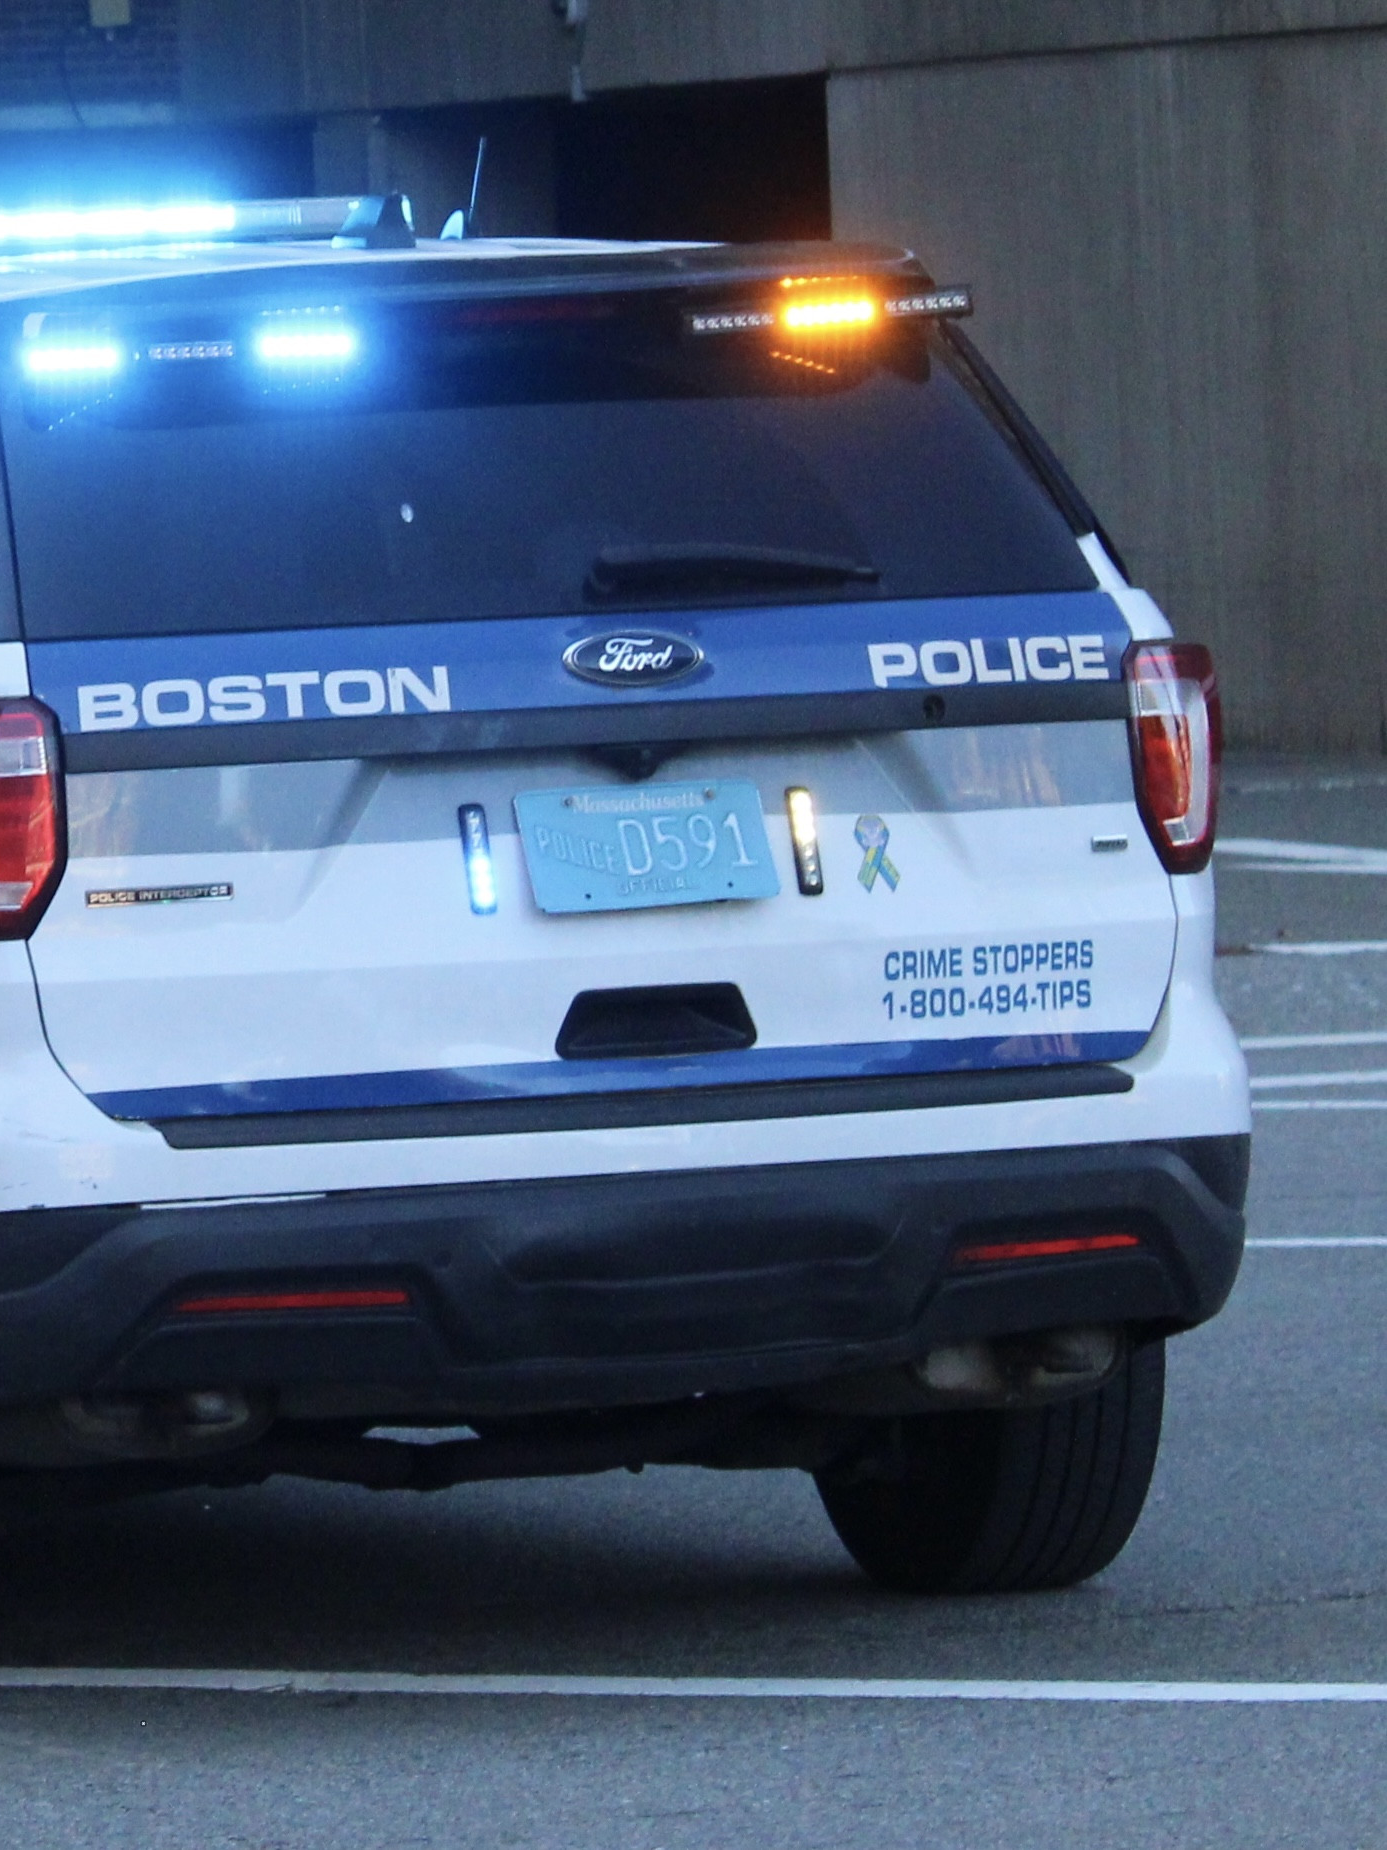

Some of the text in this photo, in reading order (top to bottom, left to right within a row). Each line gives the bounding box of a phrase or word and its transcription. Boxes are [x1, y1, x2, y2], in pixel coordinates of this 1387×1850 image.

[599, 637, 673, 672] Ford
[867, 634, 1109, 689] POLICE
[77, 665, 452, 733] BOSTON
[568, 791, 706, 814] Massachusetts
[534, 824, 621, 876] POLICE
[617, 811, 760, 877] D591
[89, 884, 229, 904] POLICE INTERCEPTOR
[884, 939, 1094, 981] CRIME STOPPERS
[882, 979, 1092, 1021] 1-800-494-TIPS
